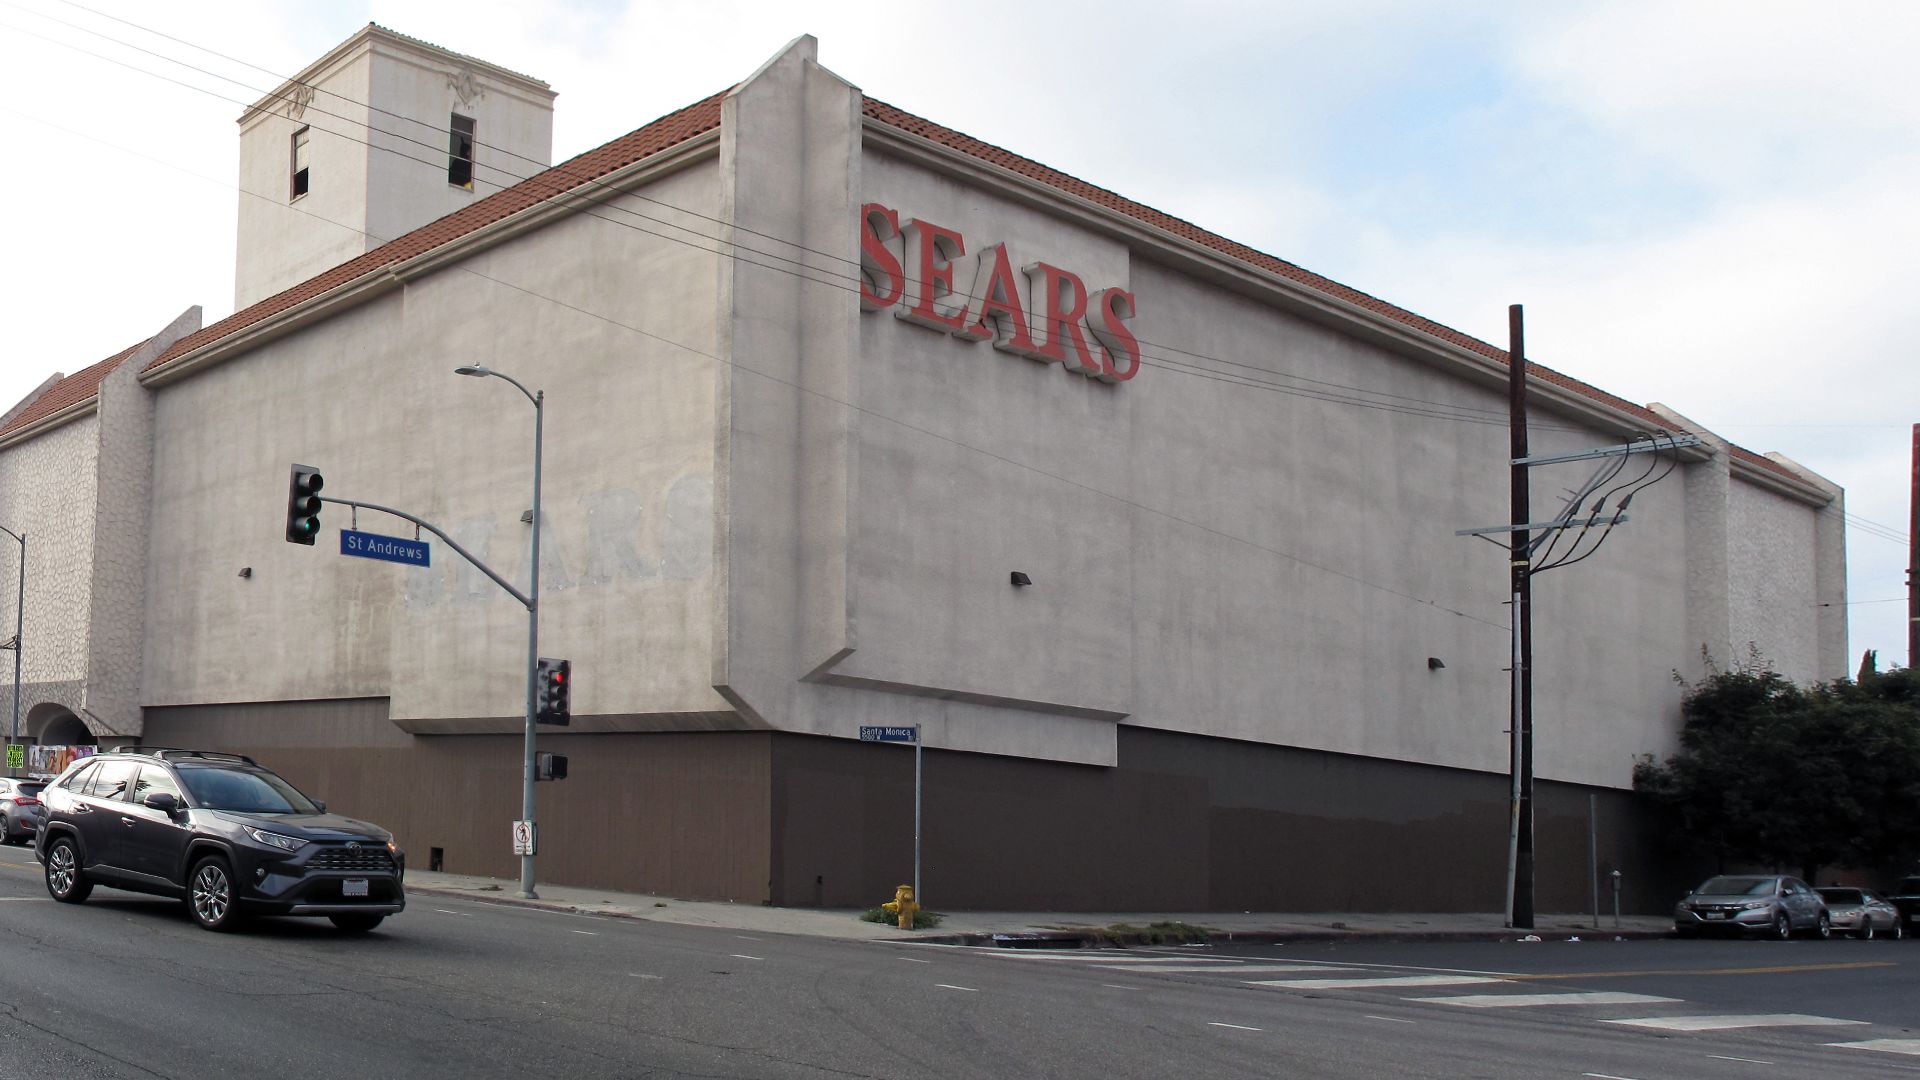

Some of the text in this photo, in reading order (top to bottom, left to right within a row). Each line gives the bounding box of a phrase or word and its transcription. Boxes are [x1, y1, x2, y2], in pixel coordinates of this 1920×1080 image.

[860, 202, 1141, 383] SEARS
[347, 535, 423, 560] St Andrews
[861, 727, 911, 736] Santa Monica
